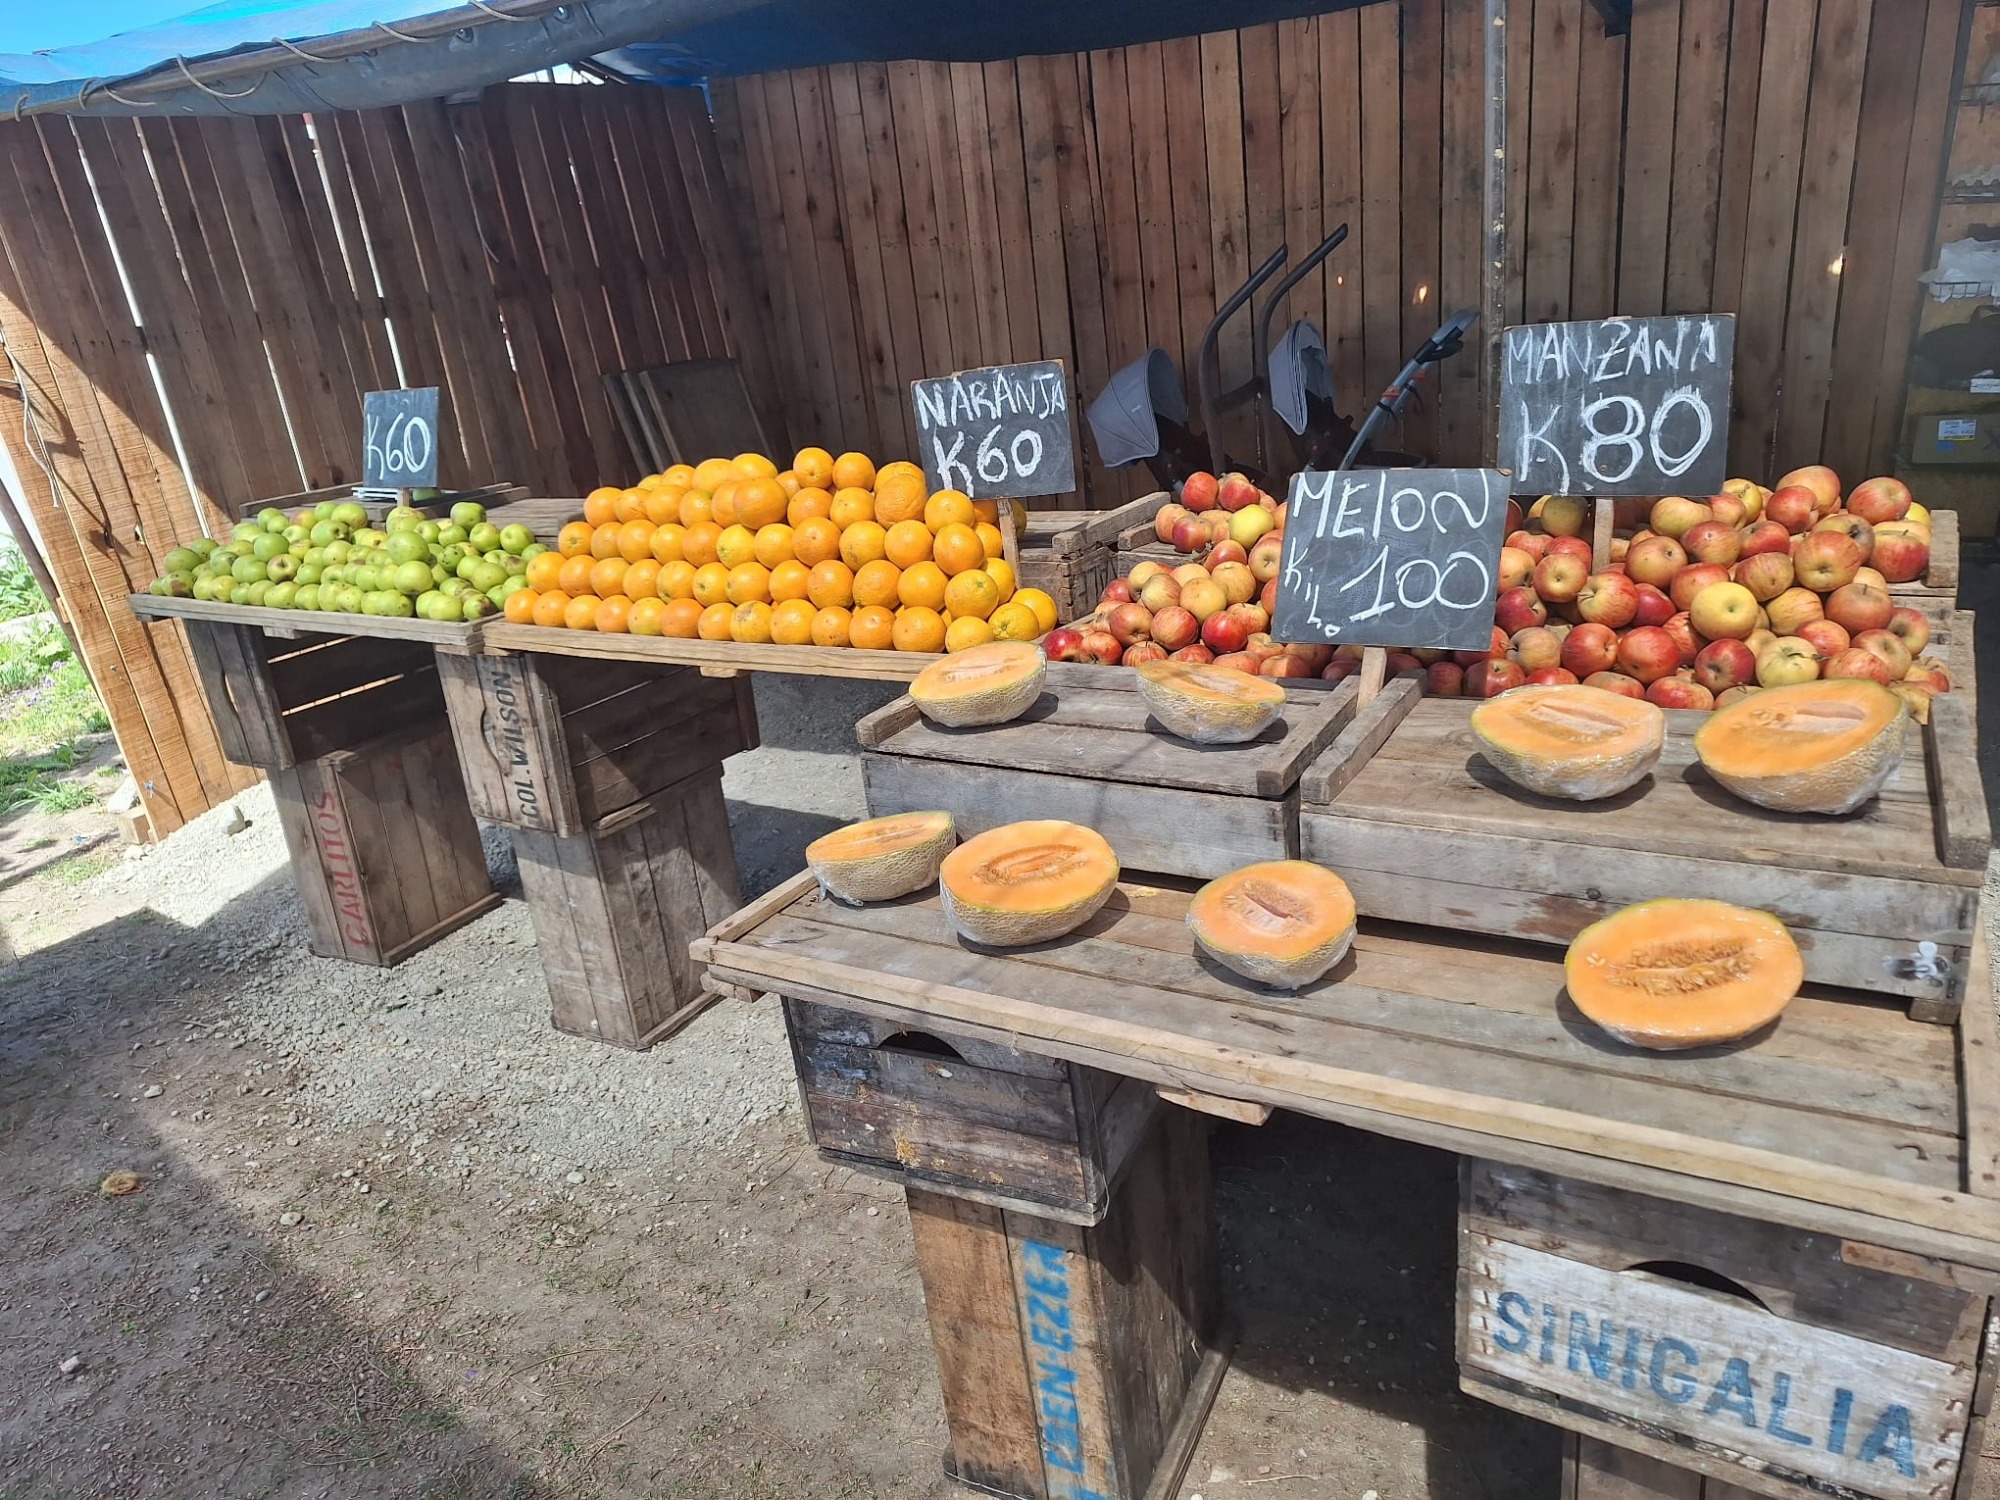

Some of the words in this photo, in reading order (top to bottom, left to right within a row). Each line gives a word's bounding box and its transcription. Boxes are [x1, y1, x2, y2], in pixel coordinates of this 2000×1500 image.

[1508, 315, 1716, 384] MANZANA
[915, 370, 1065, 431] NARANJA
[366, 412, 431, 480] K60
[932, 424, 1043, 499] K60
[1515, 386, 1713, 496] K80
[1339, 545, 1490, 622] 100
[313, 791, 371, 947] CARLITOS
[1494, 1290, 1918, 1479] SINIGALIA
